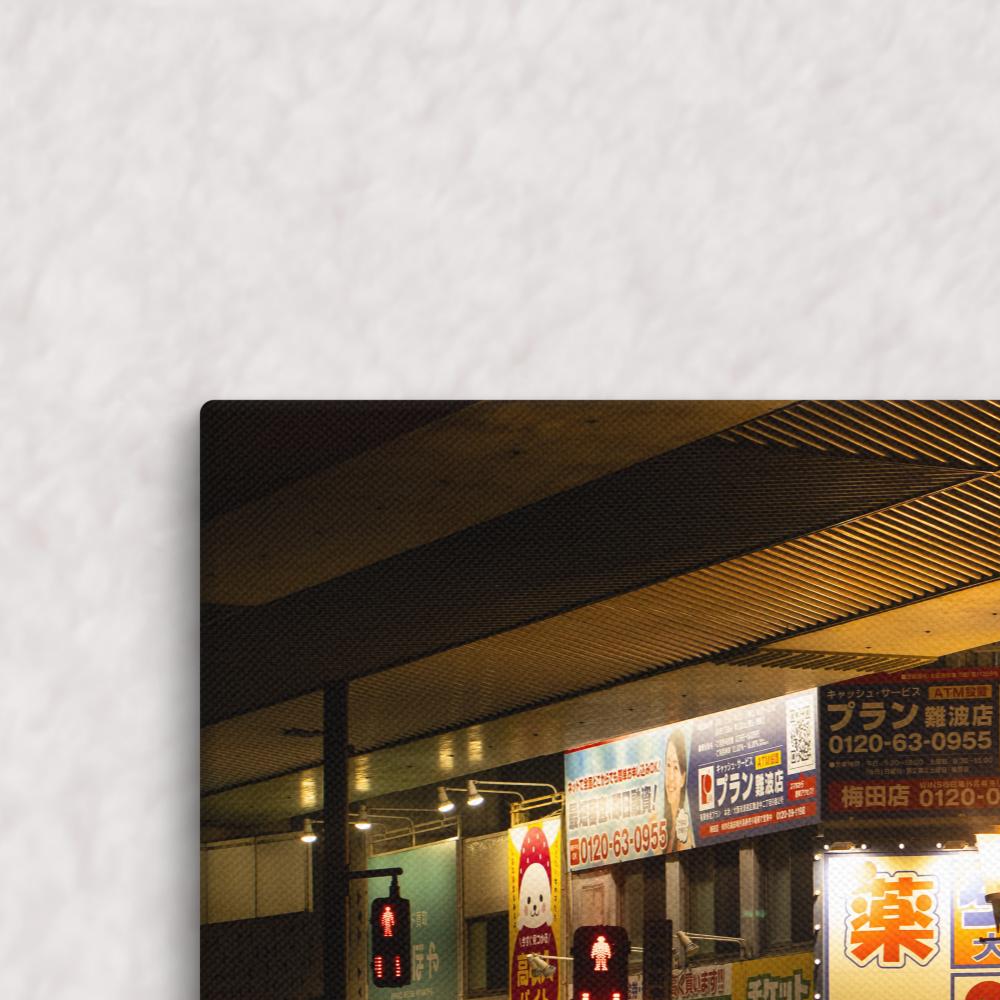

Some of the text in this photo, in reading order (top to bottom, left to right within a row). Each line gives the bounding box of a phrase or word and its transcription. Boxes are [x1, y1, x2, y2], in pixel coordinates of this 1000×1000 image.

[826, 701, 993, 732] プラン 難波店
[828, 731, 993, 754] 0120-63-0955
[716, 771, 754, 807] プラン
[841, 785, 910, 809] 梅田店
[580, 820, 668, 864] 0120-63-0955
[849, 876, 935, 963] 薬
